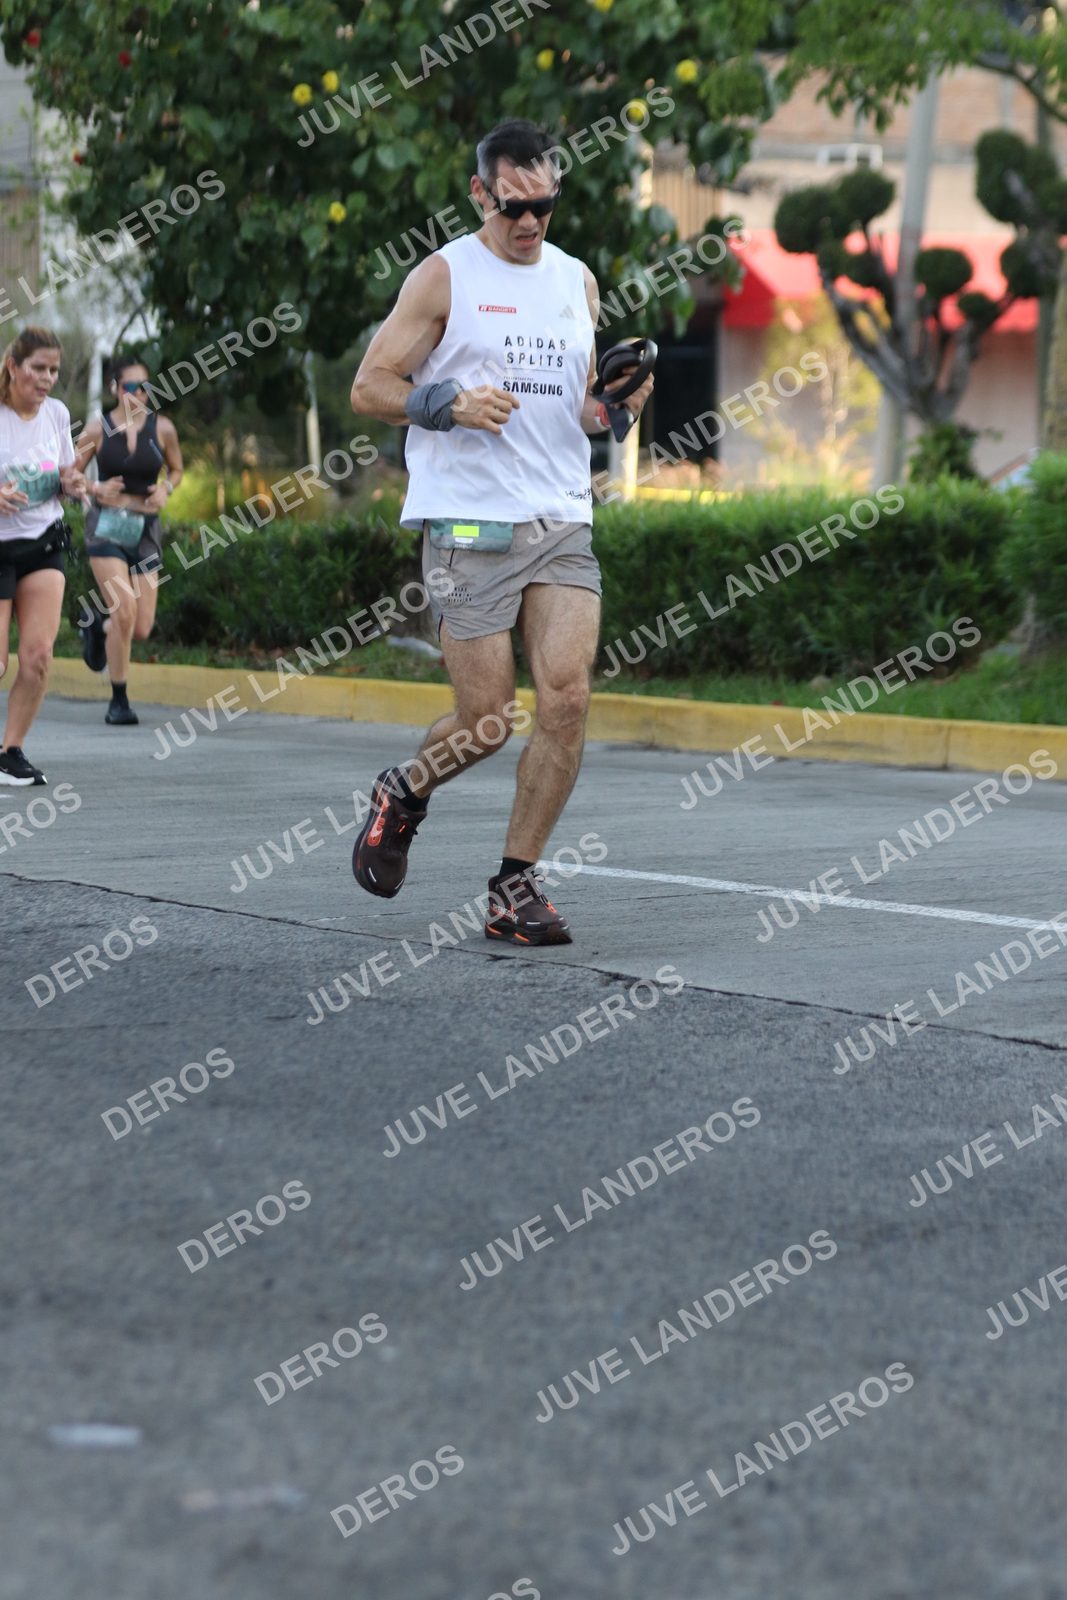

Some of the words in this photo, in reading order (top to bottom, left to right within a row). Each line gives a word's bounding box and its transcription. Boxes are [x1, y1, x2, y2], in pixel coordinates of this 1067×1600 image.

[504, 336, 566, 351] ADIDAS
[506, 352, 563, 367] SPLITS
[503, 381, 563, 396] SAMSUNG
